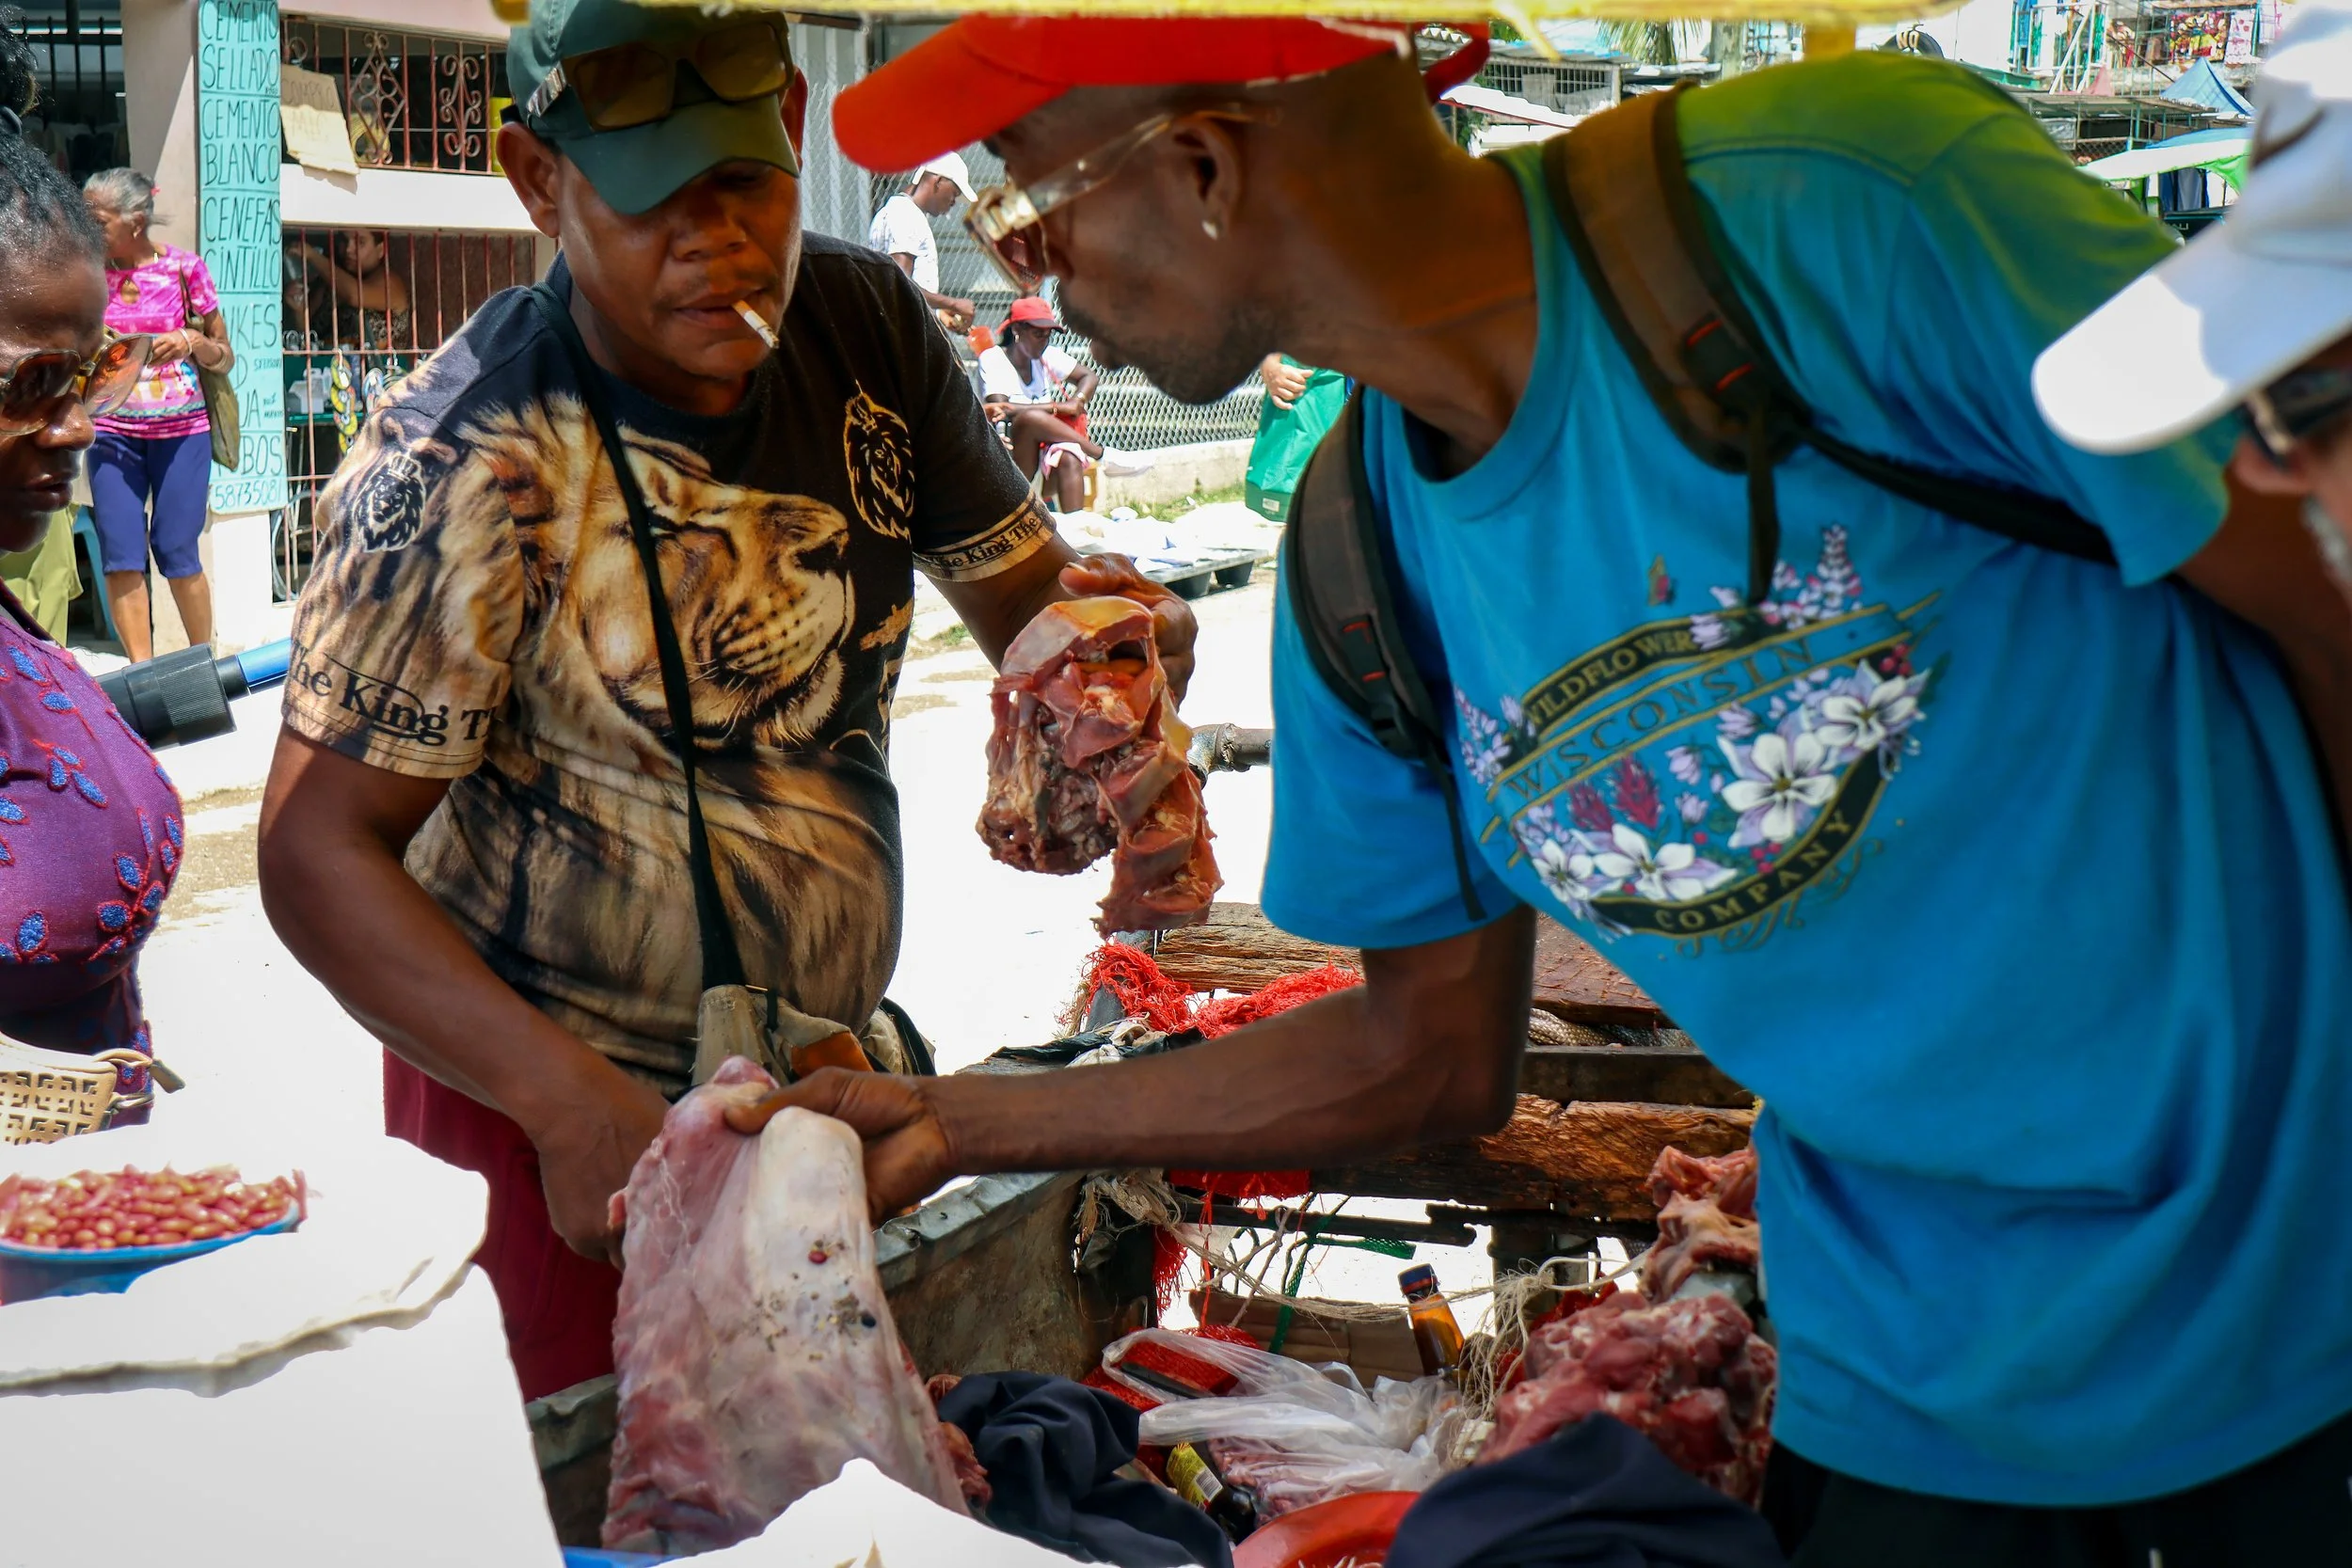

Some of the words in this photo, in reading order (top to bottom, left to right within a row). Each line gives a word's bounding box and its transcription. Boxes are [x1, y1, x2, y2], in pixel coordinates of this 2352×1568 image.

[200, 0, 279, 43] CEMENTO
[201, 43, 279, 90] SELLADO
[200, 98, 280, 140] CEMENTO
[203, 142, 280, 185] BLANCO
[203, 196, 282, 245] CENEFAS
[218, 435, 283, 477] BOS
[215, 478, 281, 510] 58735081
[963, 535, 1014, 564] King
[1009, 516, 1039, 542] The
[339, 671, 449, 748] King
[1503, 637, 1814, 800] WISCONSIN
[1654, 809, 1851, 930] COMPANY
